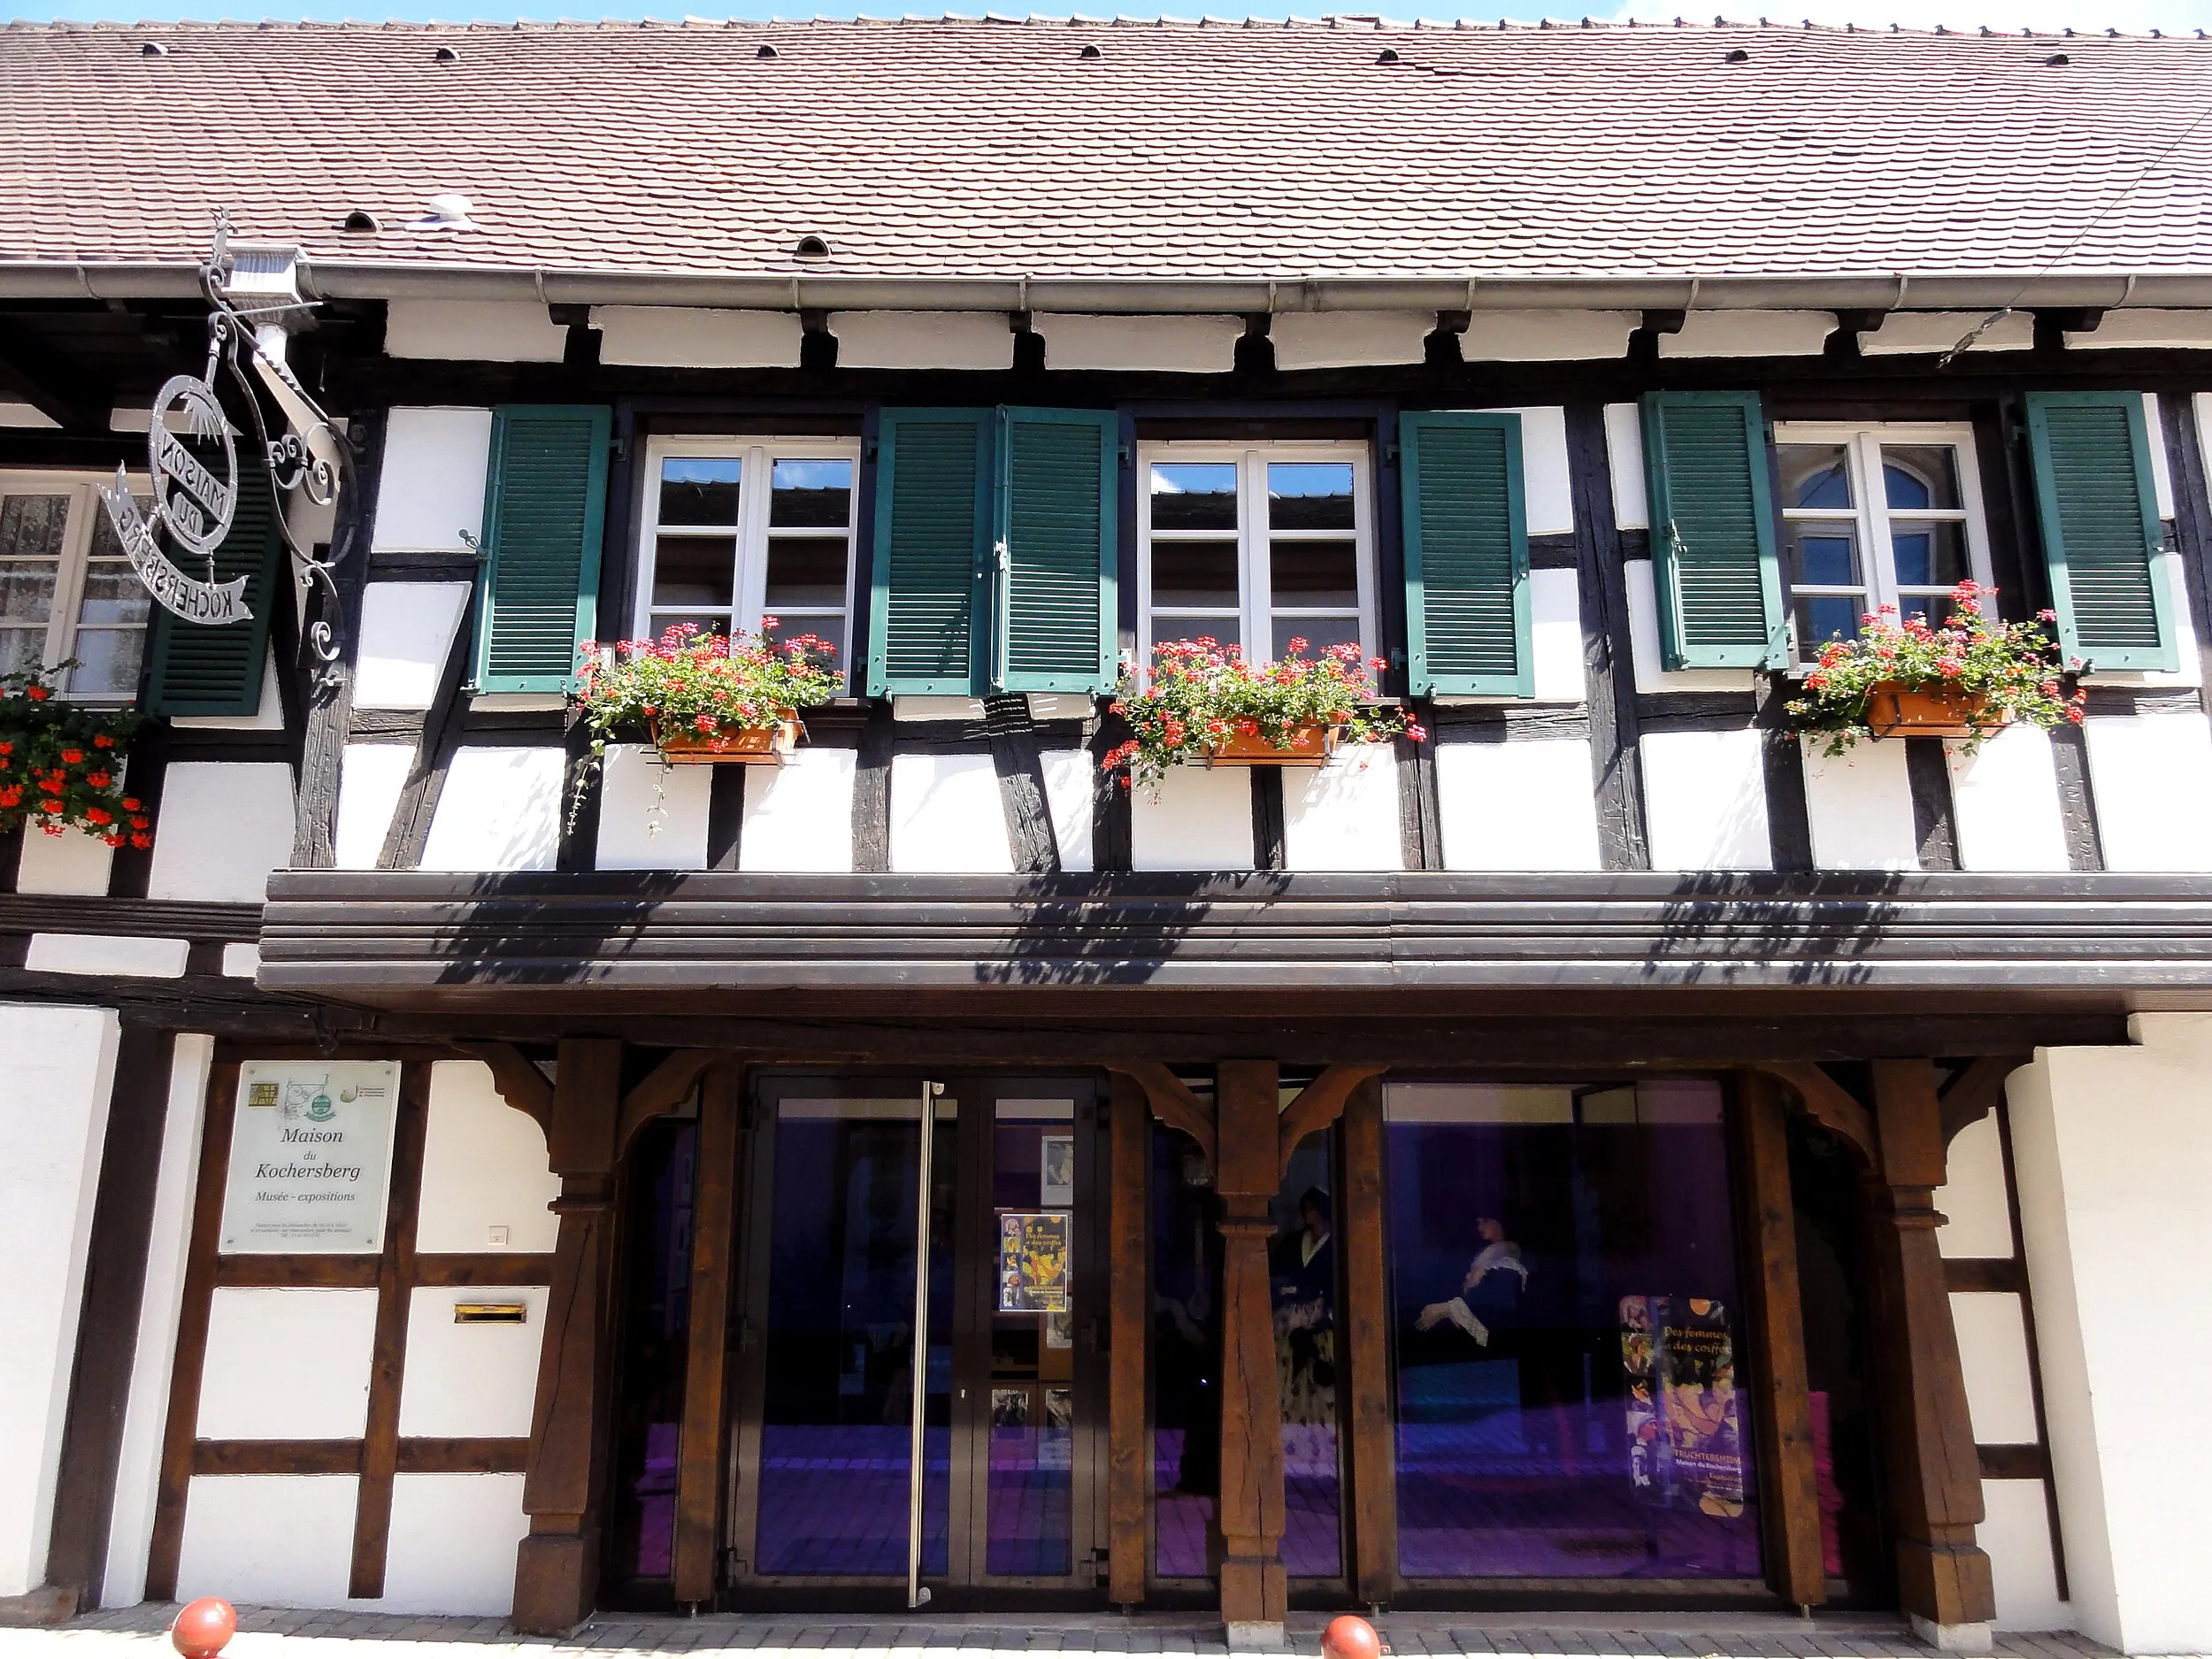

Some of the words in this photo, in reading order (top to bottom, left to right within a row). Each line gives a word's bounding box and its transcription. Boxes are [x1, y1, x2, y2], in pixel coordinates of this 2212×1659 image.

[280, 1127, 343, 1144] Maison
[303, 1149, 317, 1161] du
[255, 1163, 361, 1182] Kochersberg
[254, 1191, 289, 1202] Musée
[297, 1191, 356, 1203] expositions
[1663, 1325, 1683, 1338] Des
[1683, 1325, 1729, 1340] femmes
[1673, 1340, 1693, 1352] des
[1694, 1340, 1732, 1356] coiffes
